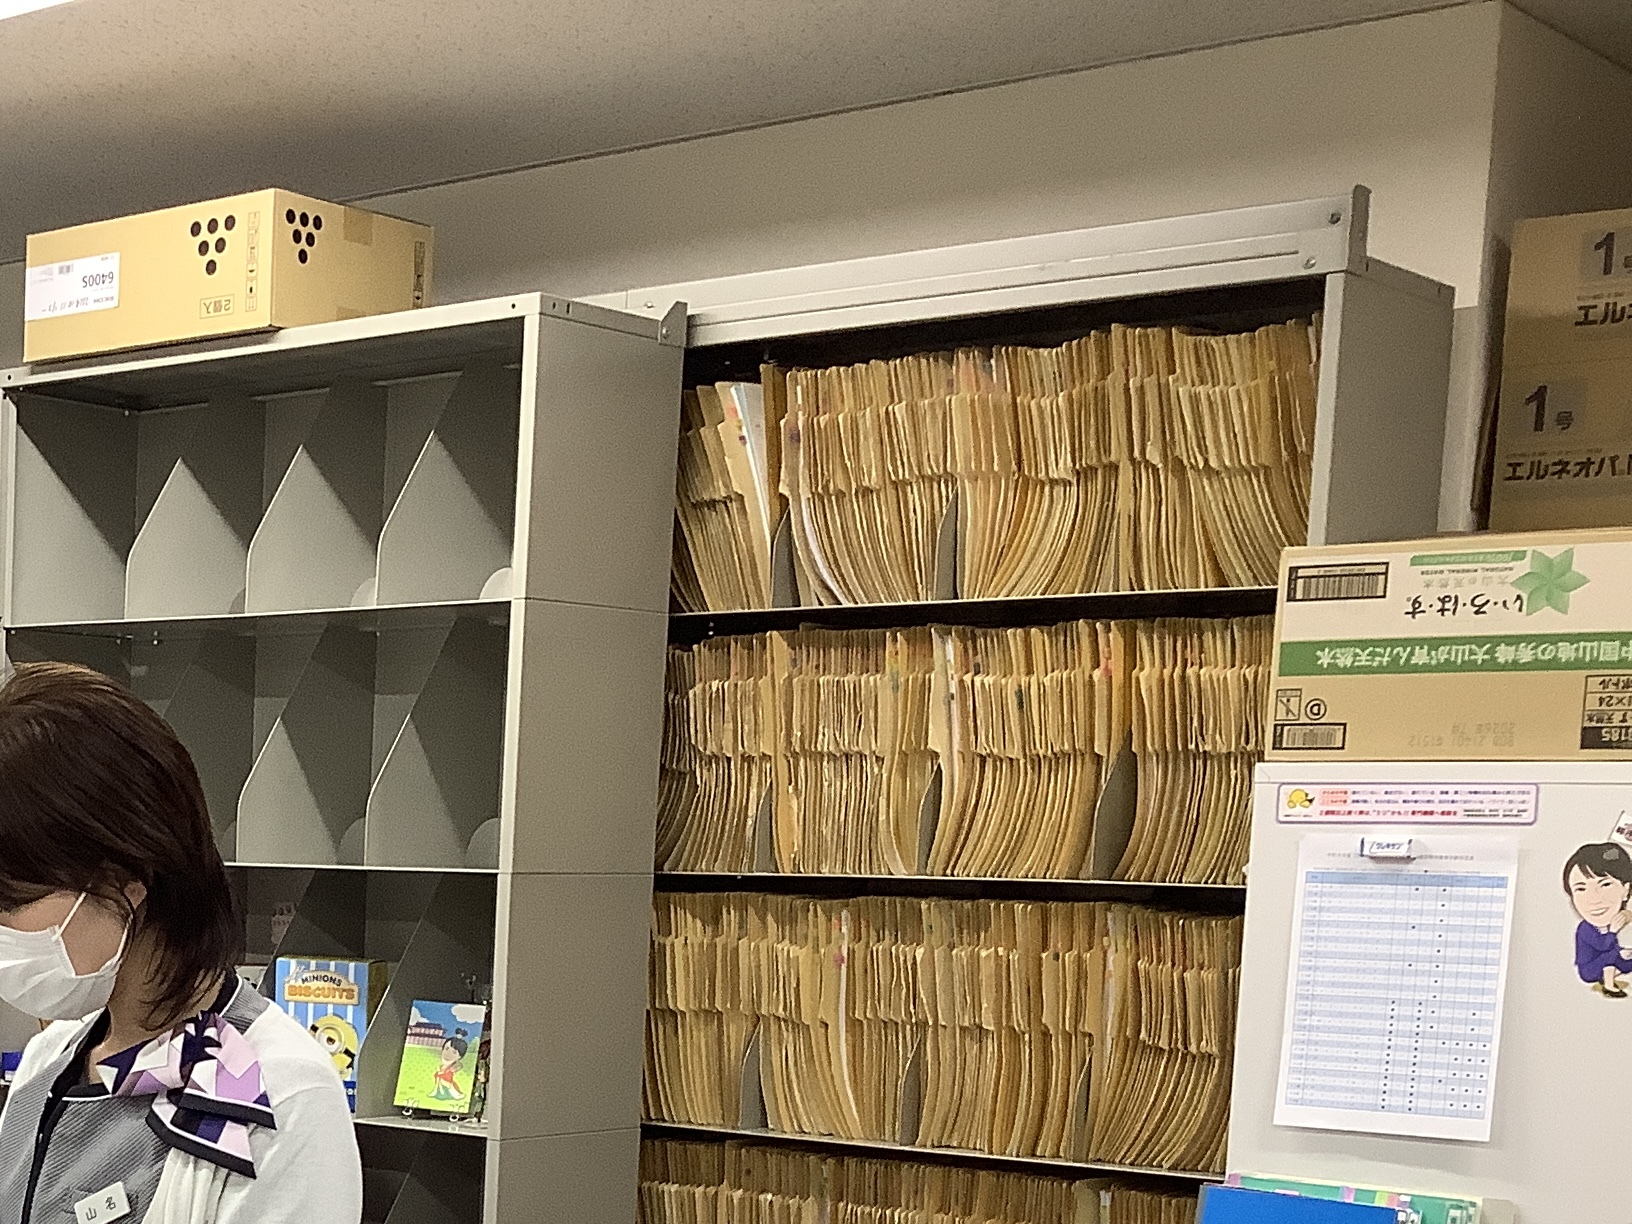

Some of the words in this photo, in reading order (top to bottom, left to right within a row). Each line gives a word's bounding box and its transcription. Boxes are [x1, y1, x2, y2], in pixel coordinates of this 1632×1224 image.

[82, 271, 114, 289] 6400S
[1524, 384, 1574, 432] 1号
[1315, 643, 1491, 669] 大山が育んだ天然水
[301, 974, 342, 987] MINIONS
[288, 984, 356, 1000] BISCUITS
